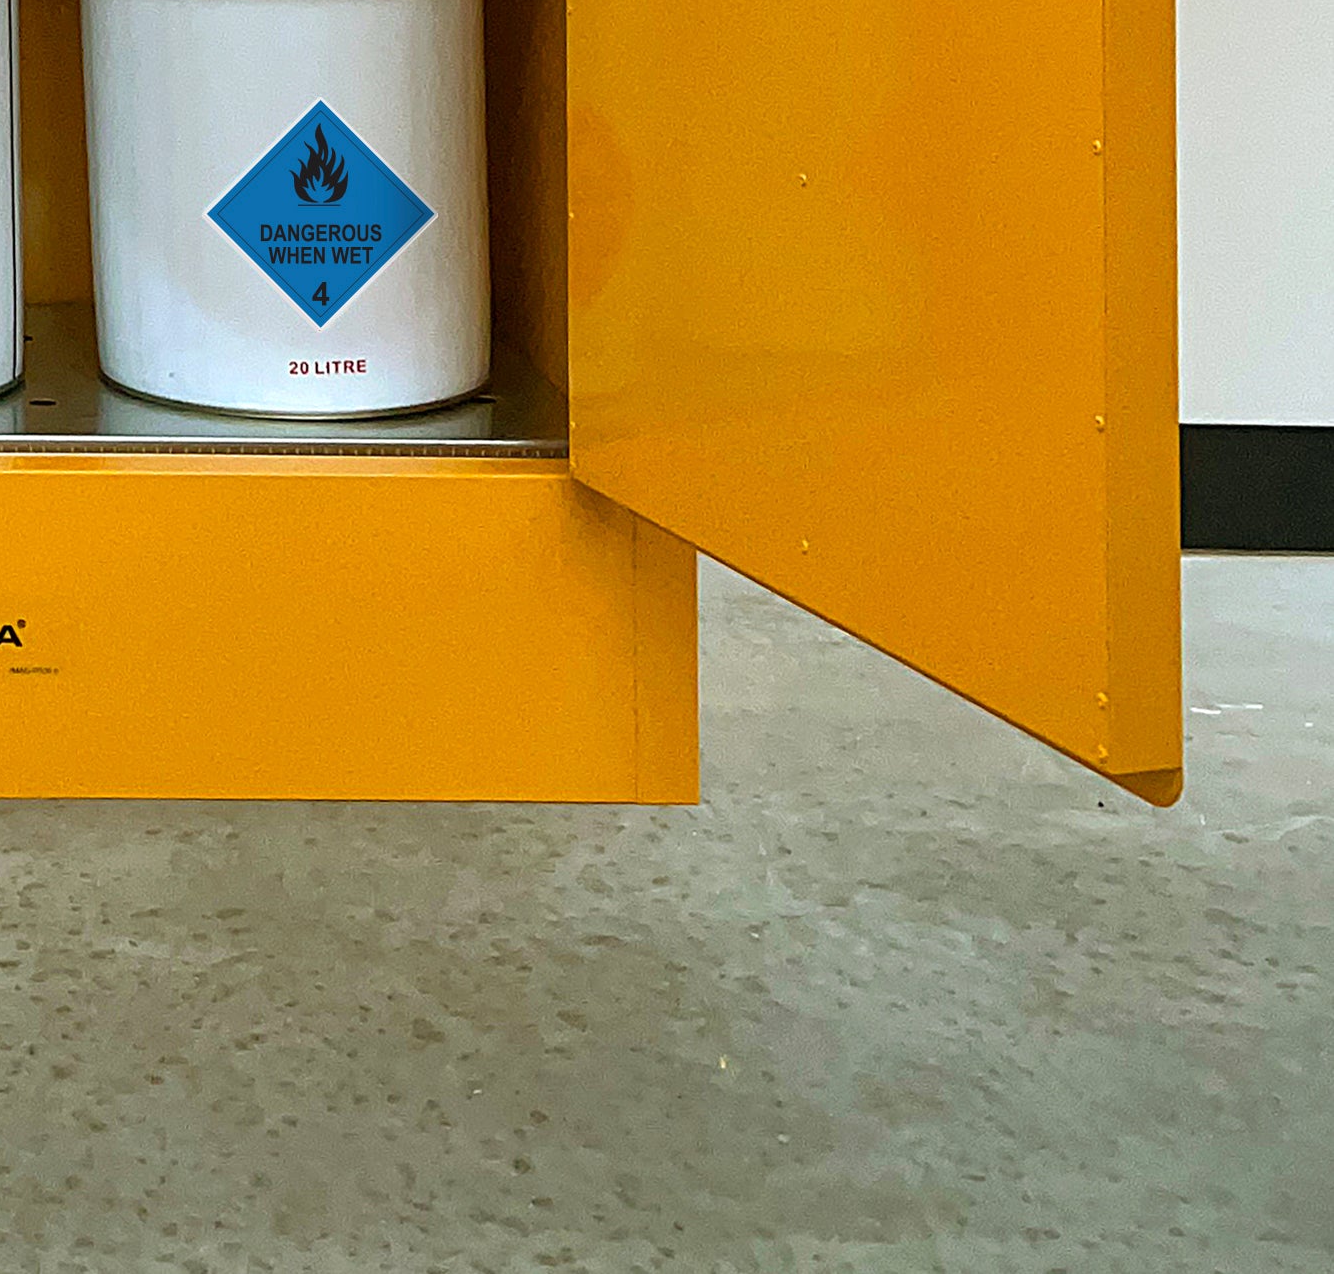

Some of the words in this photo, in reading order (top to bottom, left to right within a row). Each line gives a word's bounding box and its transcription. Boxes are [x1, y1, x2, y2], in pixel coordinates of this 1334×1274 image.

[259, 223, 383, 242] DANGEROUS
[268, 246, 326, 265] WHEN
[331, 246, 374, 265] WET
[311, 281, 330, 306] 4
[288, 361, 310, 376] 20
[314, 359, 367, 375] LITRE
